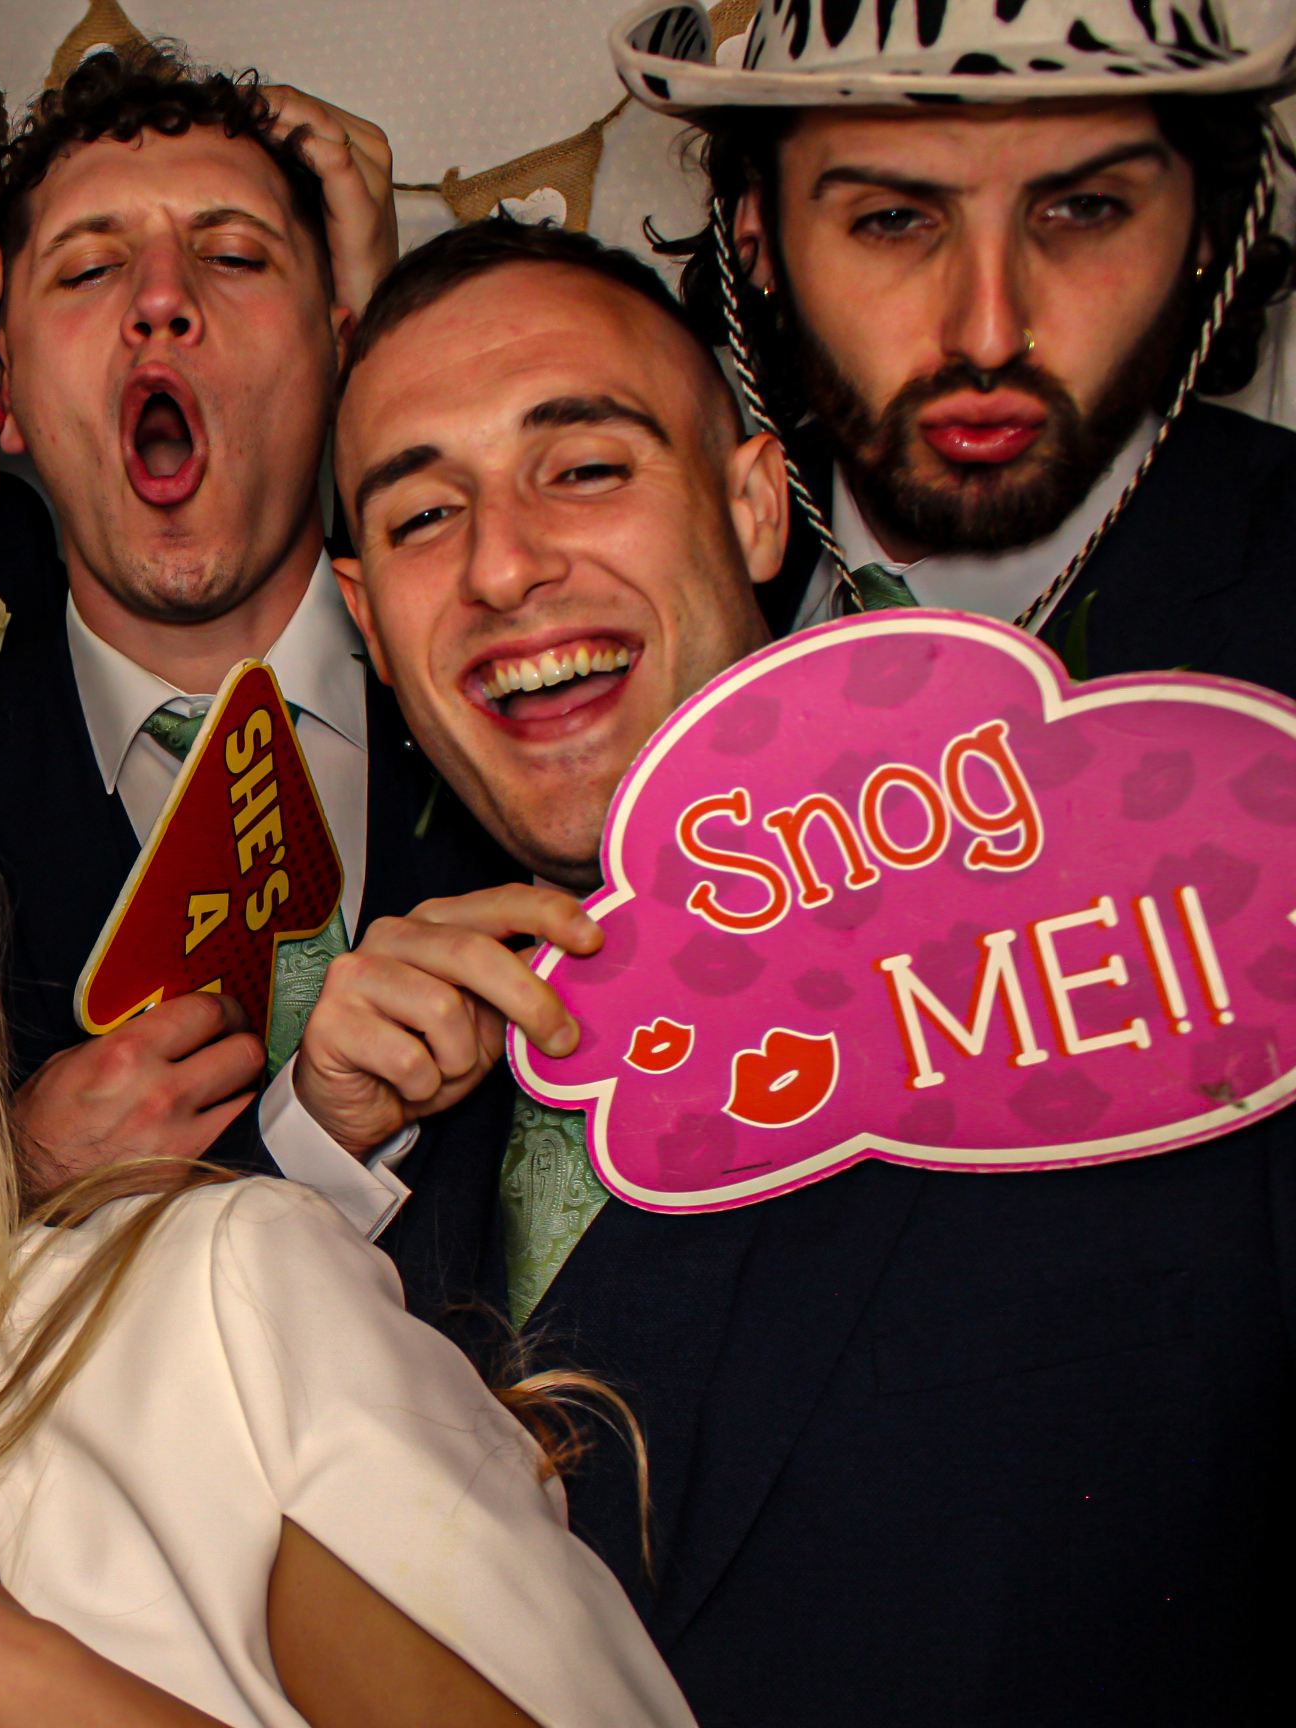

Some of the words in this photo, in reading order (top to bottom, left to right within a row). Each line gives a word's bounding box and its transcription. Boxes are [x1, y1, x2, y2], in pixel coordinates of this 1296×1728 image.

[185, 893, 229, 955] A
[225, 709, 290, 931] SHE'S
[676, 719, 1044, 935] Snog
[872, 886, 1235, 1089] ME!!
